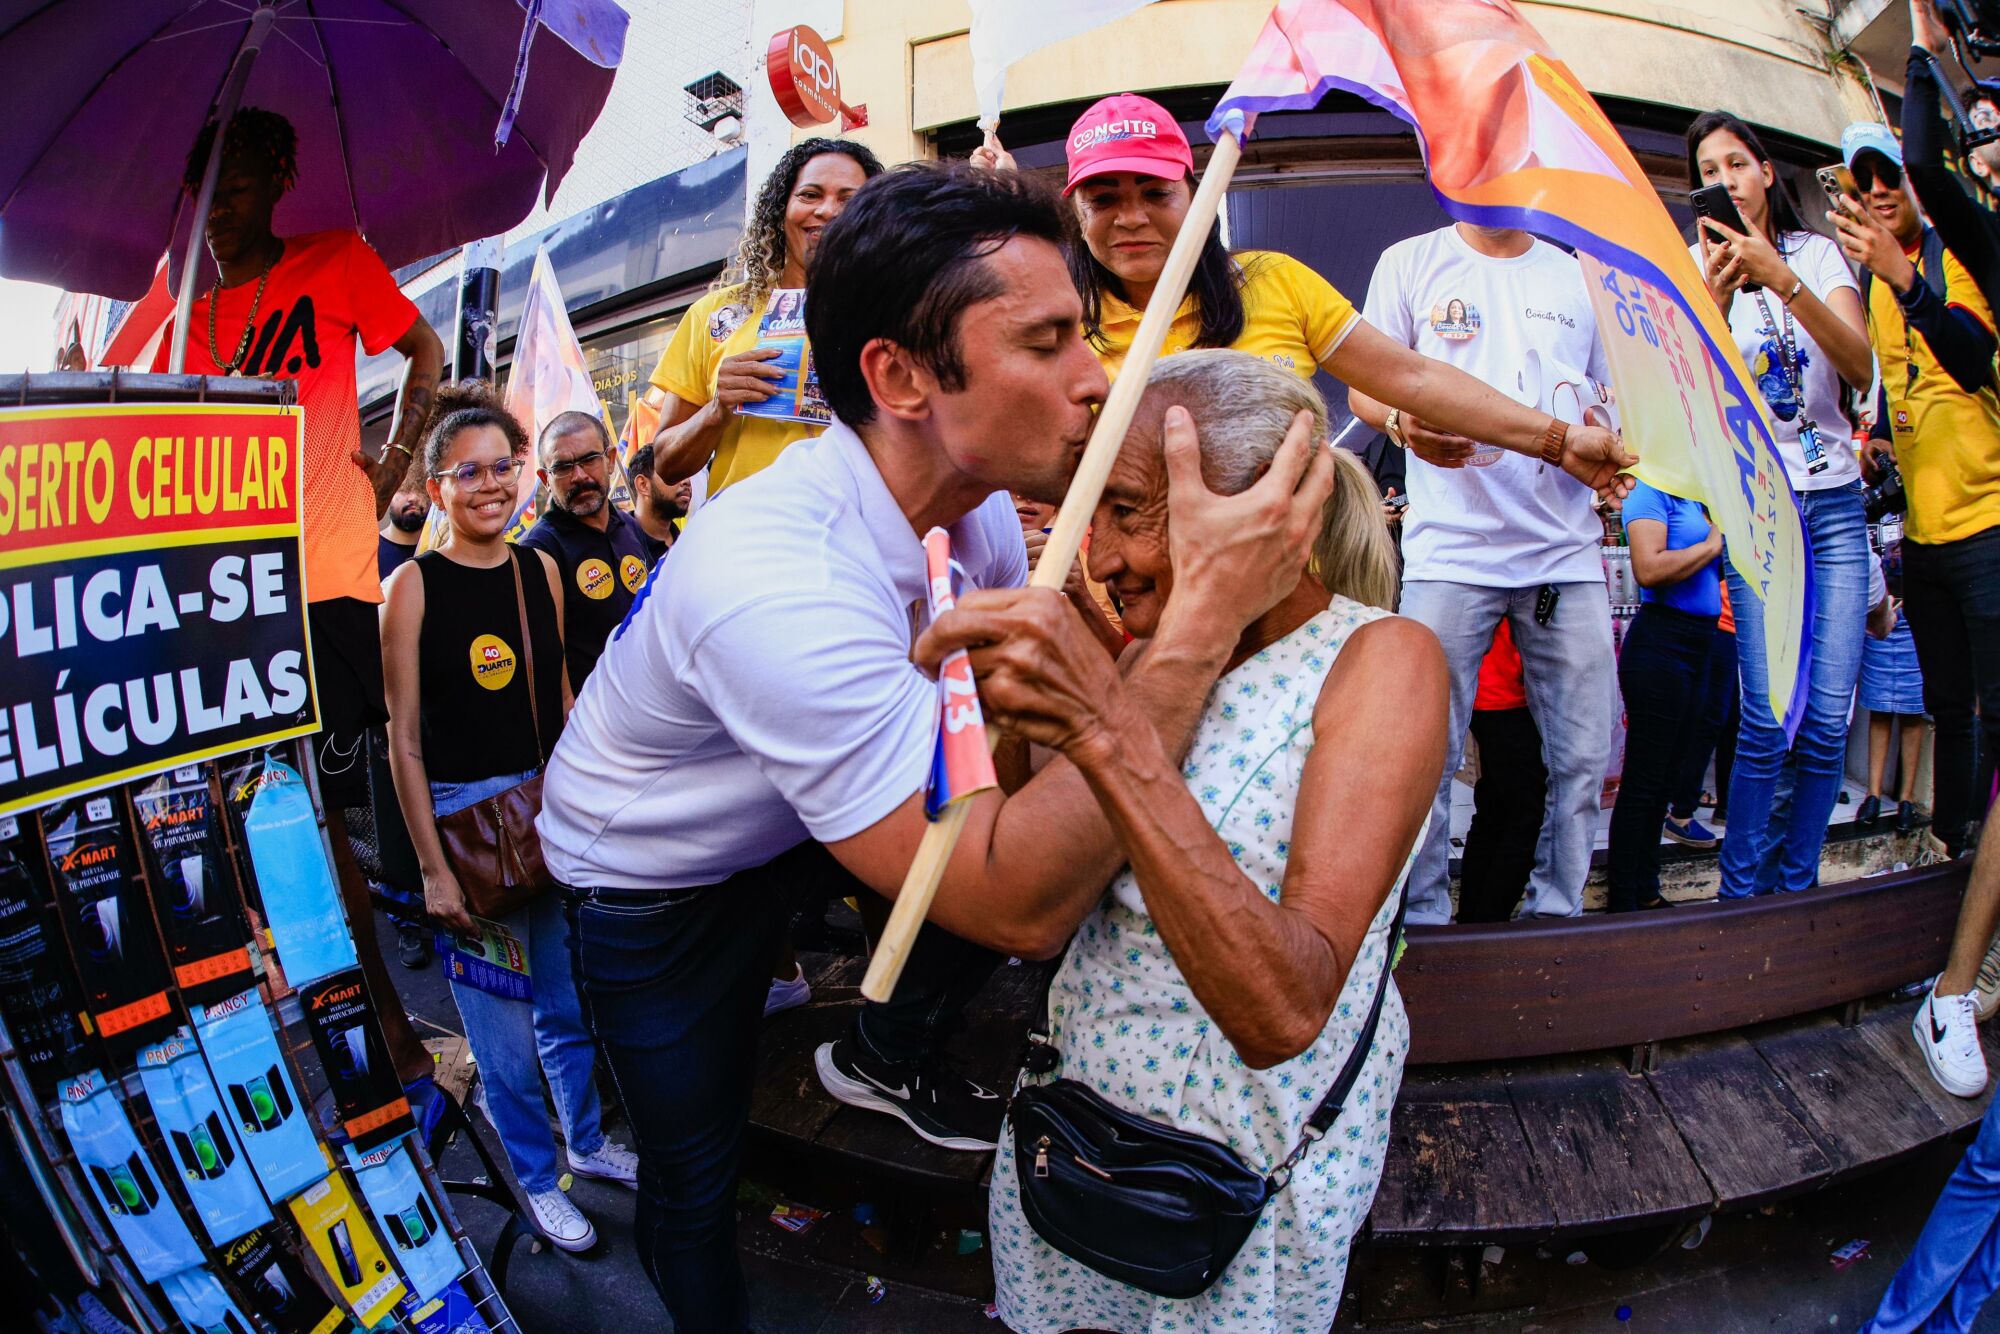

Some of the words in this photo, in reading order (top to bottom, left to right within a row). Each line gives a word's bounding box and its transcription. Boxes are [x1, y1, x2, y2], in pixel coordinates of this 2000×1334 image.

[1074, 119, 1157, 148] CONCITA
[1526, 308, 1555, 322] Concita
[1558, 314, 1576, 329] Pinto
[594, 378, 612, 394] DIA
[615, 370, 638, 387] DOS
[129, 436, 289, 520] CELULAR
[585, 571, 612, 591] DUARTE
[588, 569, 599, 579] 40
[0, 551, 288, 658] LICA-SE
[484, 647, 500, 659] 40
[477, 657, 513, 674] DUARTE
[147, 805, 204, 831] X-MART
[153, 839, 163, 849] DE
[164, 830, 207, 848] PRIVACIDADE
[62, 844, 117, 872] X-MART
[69, 881, 79, 892] DE
[80, 870, 121, 889] PRIVACIDADE
[312, 984, 362, 1011] X-MART
[319, 1016, 328, 1026] DE
[328, 1004, 366, 1023] PRIVACIDADE
